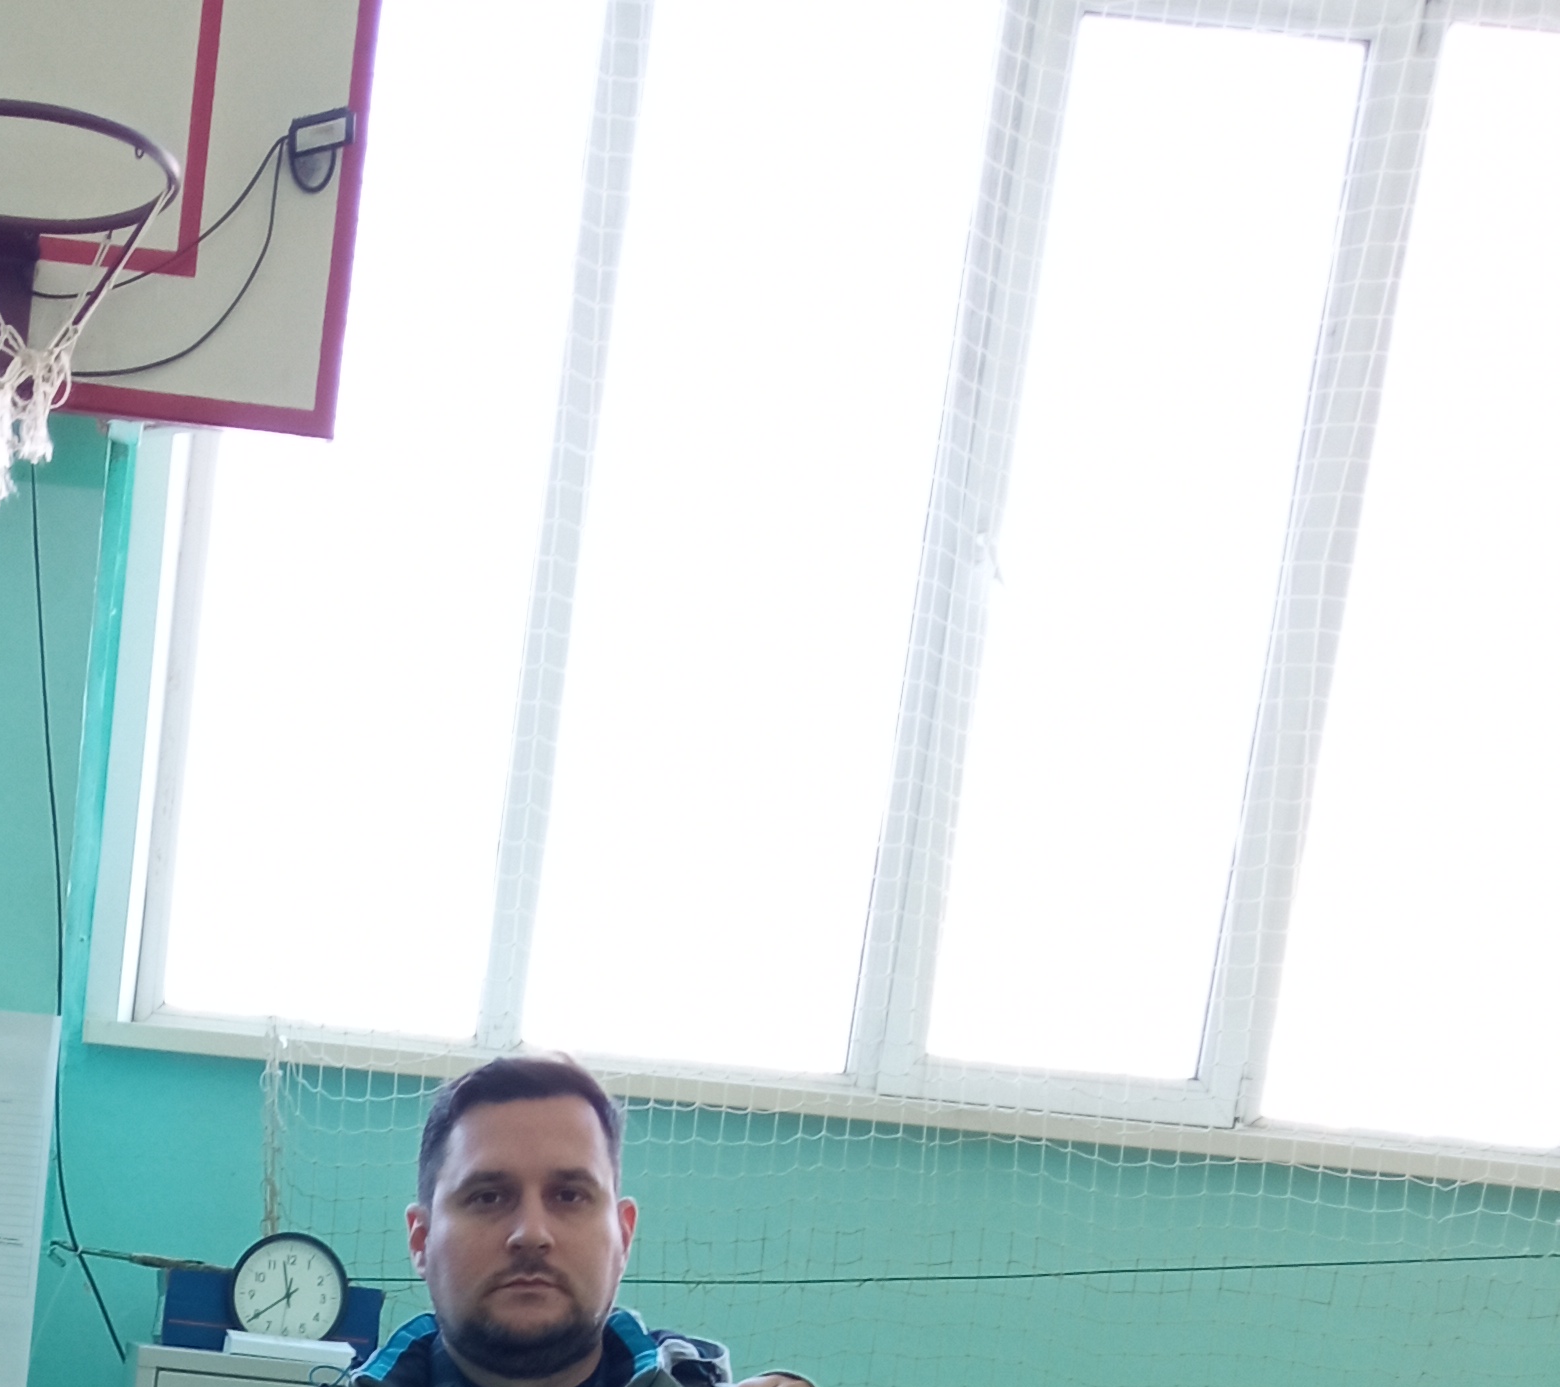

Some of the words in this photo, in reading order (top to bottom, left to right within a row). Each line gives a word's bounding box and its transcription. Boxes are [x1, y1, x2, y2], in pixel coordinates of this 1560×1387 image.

[268, 1260, 276, 1270] 11
[286, 1255, 297, 1266] 12
[255, 1272, 265, 1283] 10
[317, 1276, 324, 1286] 2
[248, 1289, 255, 1300] 9
[320, 1293, 326, 1304] 3
[312, 1312, 320, 1322] 4
[264, 1321, 272, 1331] 7
[299, 1323, 306, 1334] 5
